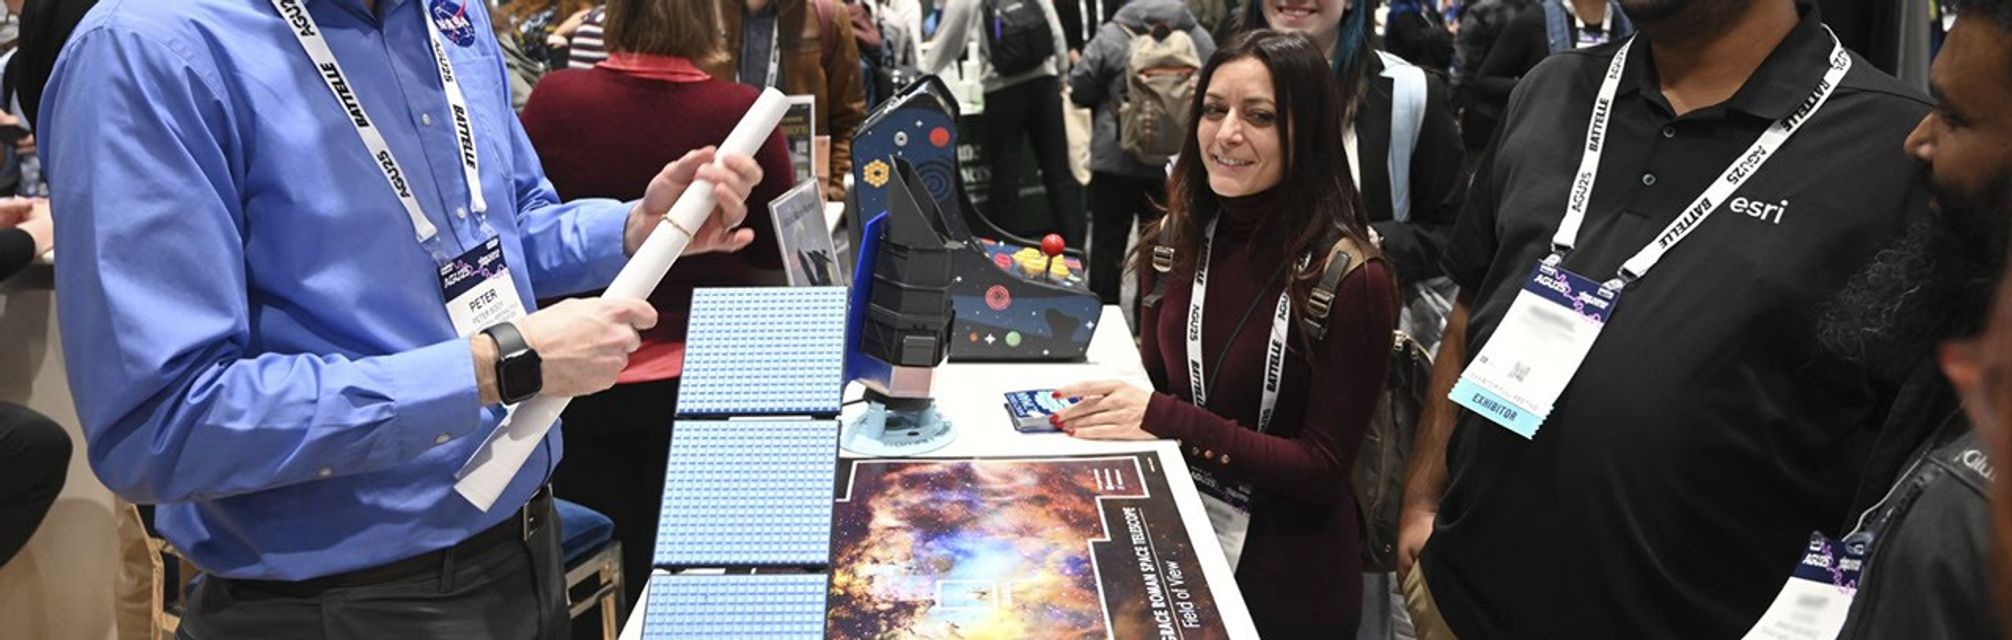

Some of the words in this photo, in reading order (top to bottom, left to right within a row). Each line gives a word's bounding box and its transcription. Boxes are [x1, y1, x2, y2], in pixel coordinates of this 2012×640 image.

[280, 0, 315, 36] AGU2
[433, 38, 453, 83] AGU25
[320, 62, 370, 128] BATTELLE
[453, 104, 476, 169] BATTELLE
[1589, 98, 1609, 152] BATTELLE
[376, 150, 411, 199] AGU25
[1726, 145, 1767, 185] AGU25
[1571, 172, 1592, 213] AGU25
[1729, 197, 1789, 224] esri
[1658, 197, 1713, 249] BATTELLE
[469, 288, 498, 313] PETER
[1189, 304, 1200, 342] AGU25
[1266, 338, 1283, 393] BATTELLE
[1472, 393, 1518, 422] EXHIBITOR
[1122, 507, 1146, 545] TELESCOPE
[1134, 546, 1155, 572] SPACE
[1166, 560, 1185, 585] View
[1143, 573, 1166, 608] ROMAN
[1171, 587, 1190, 599] of
[1176, 601, 1200, 629] Field
